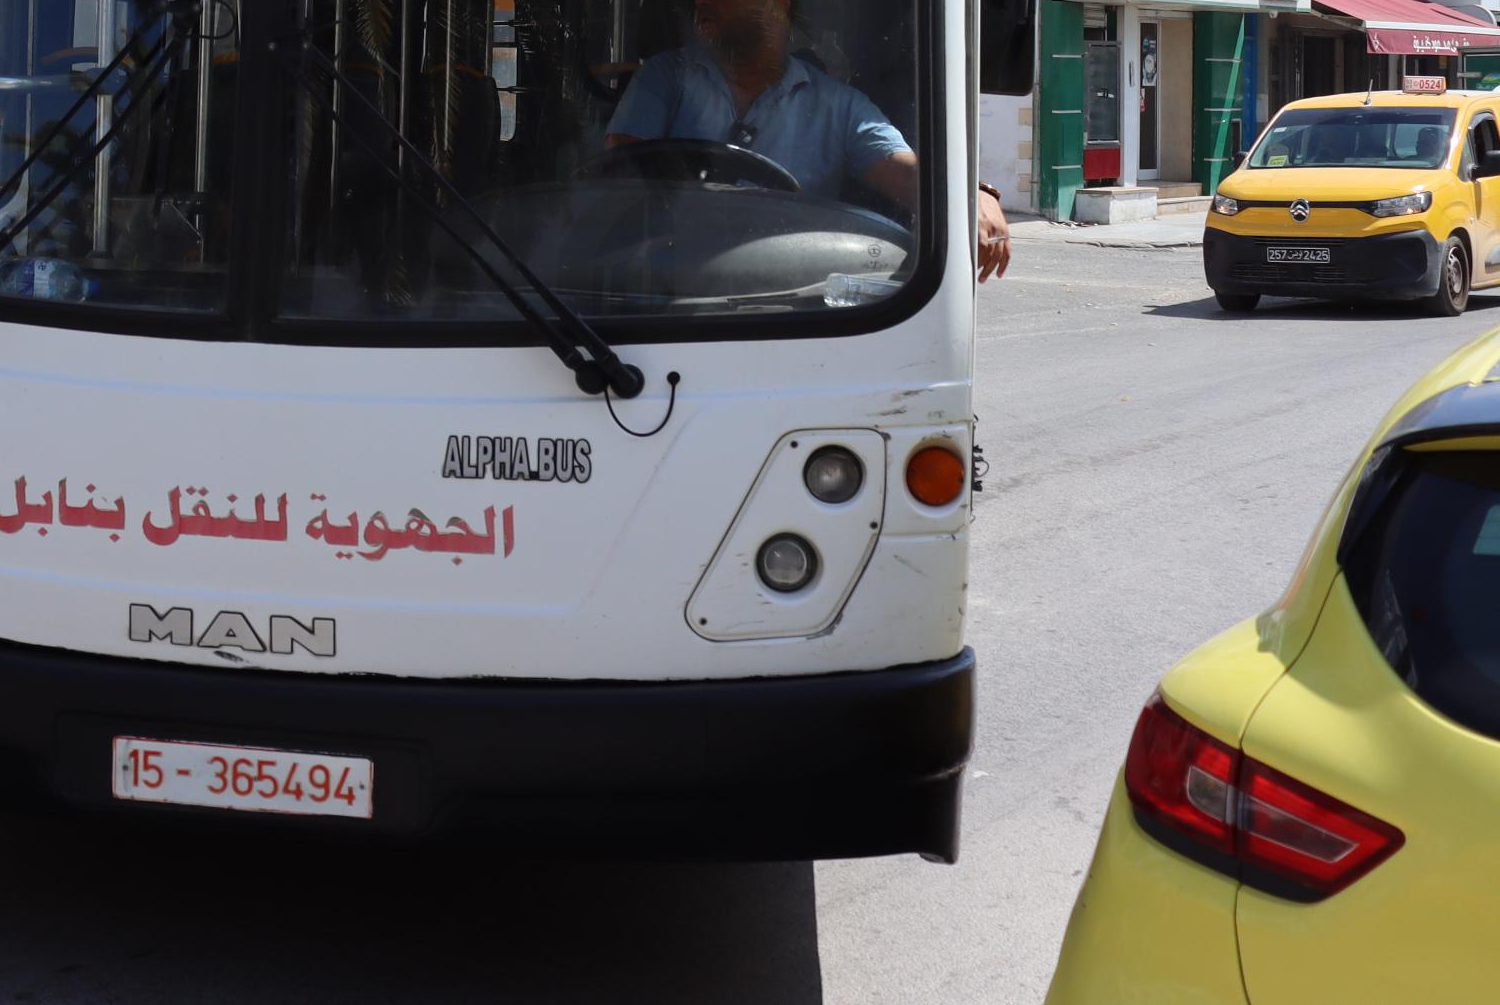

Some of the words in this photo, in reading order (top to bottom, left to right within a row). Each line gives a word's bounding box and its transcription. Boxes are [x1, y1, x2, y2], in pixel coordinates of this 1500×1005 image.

[1419, 79, 1441, 89] 0524
[1269, 249, 1287, 260] 257
[1303, 250, 1329, 261] 2425
[142, 484, 288, 546] للنقل
[305, 493, 515, 566] الجهوية
[128, 603, 337, 657] MAN
[126, 748, 164, 789] 15
[206, 755, 357, 806] 365494
